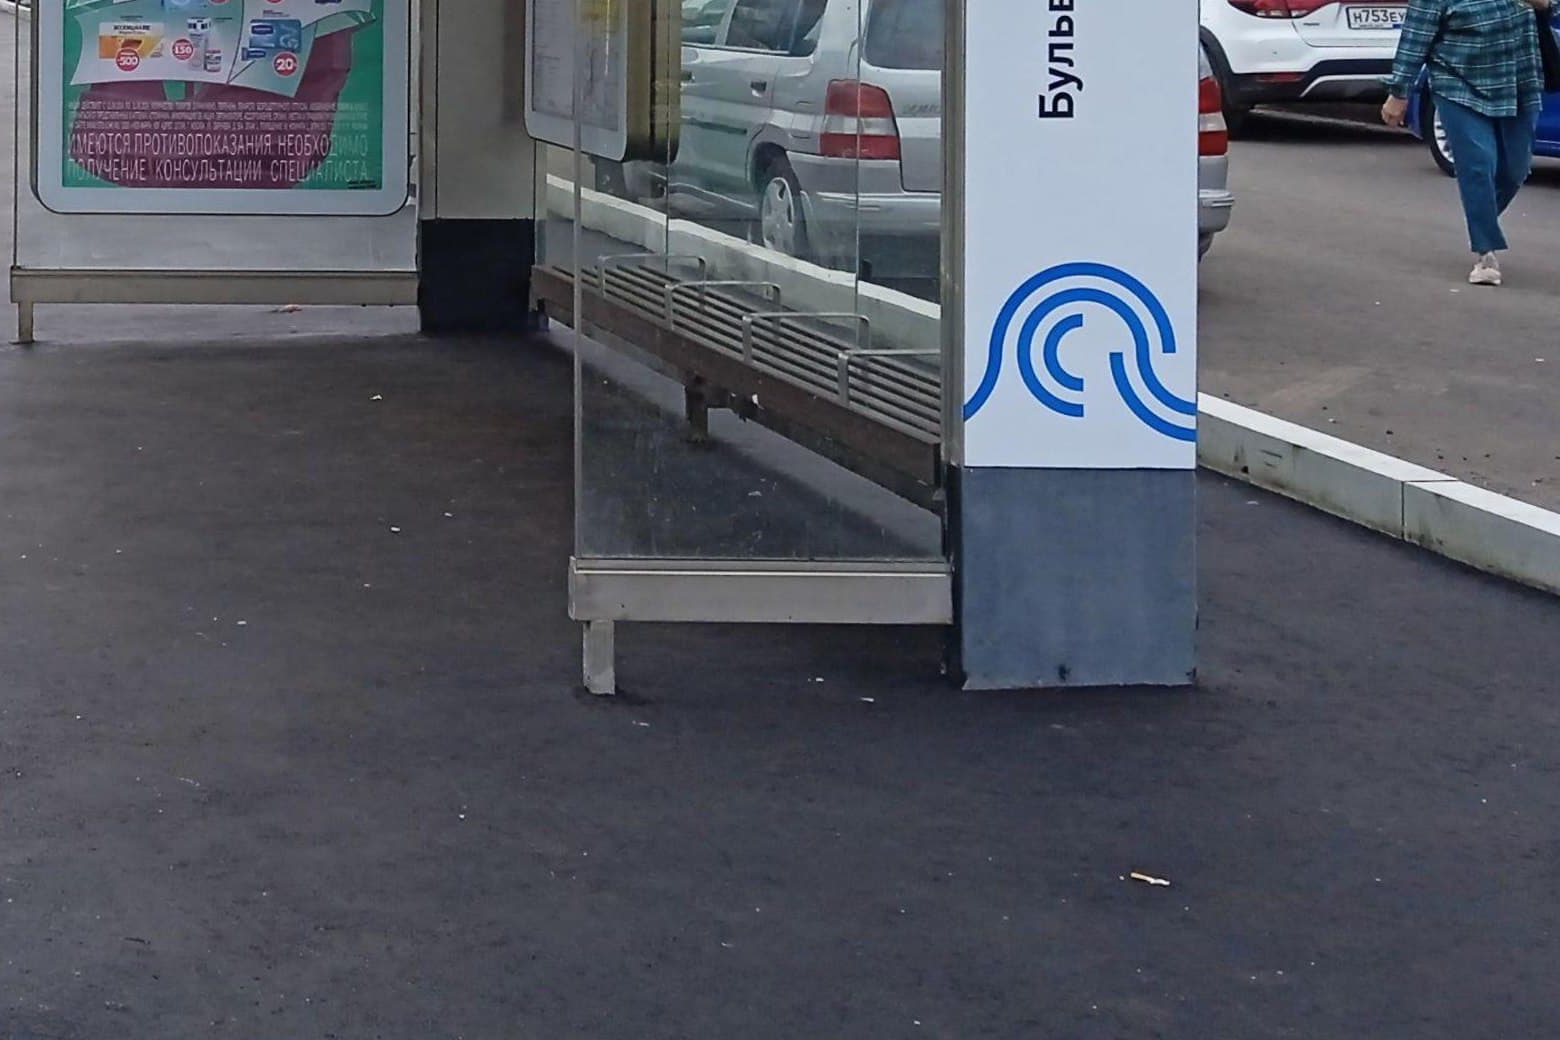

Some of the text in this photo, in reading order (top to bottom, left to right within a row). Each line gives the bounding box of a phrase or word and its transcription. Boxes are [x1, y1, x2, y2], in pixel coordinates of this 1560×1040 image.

[68, 133, 368, 157] ИМЕЮТСЯ ПРОТИВОПОКАЗАНИЯ НЕОБХОДИМО
[68, 158, 146, 181] ПОЛУЧЕНИЕ
[155, 158, 262, 183] КОНСУЛЬТАЦИИ
